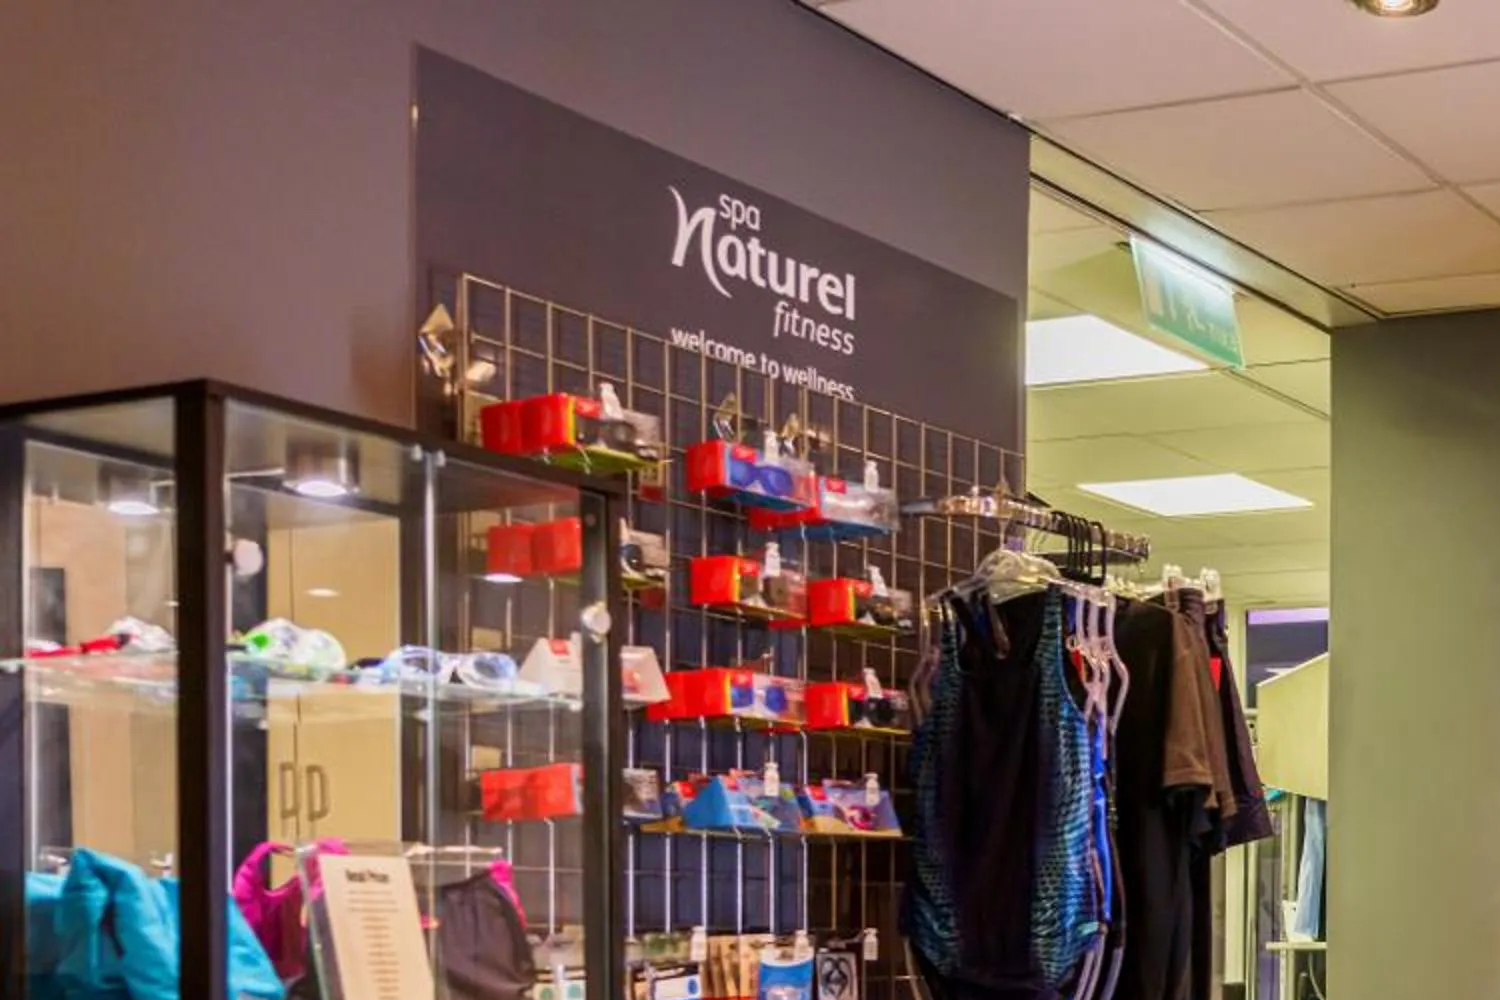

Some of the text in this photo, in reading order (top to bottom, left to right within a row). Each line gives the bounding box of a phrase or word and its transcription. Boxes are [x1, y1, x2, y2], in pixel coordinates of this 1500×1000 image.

[719, 193, 760, 232] spa
[773, 301, 855, 355] fitness
[671, 328, 856, 401] welcome to wellness
